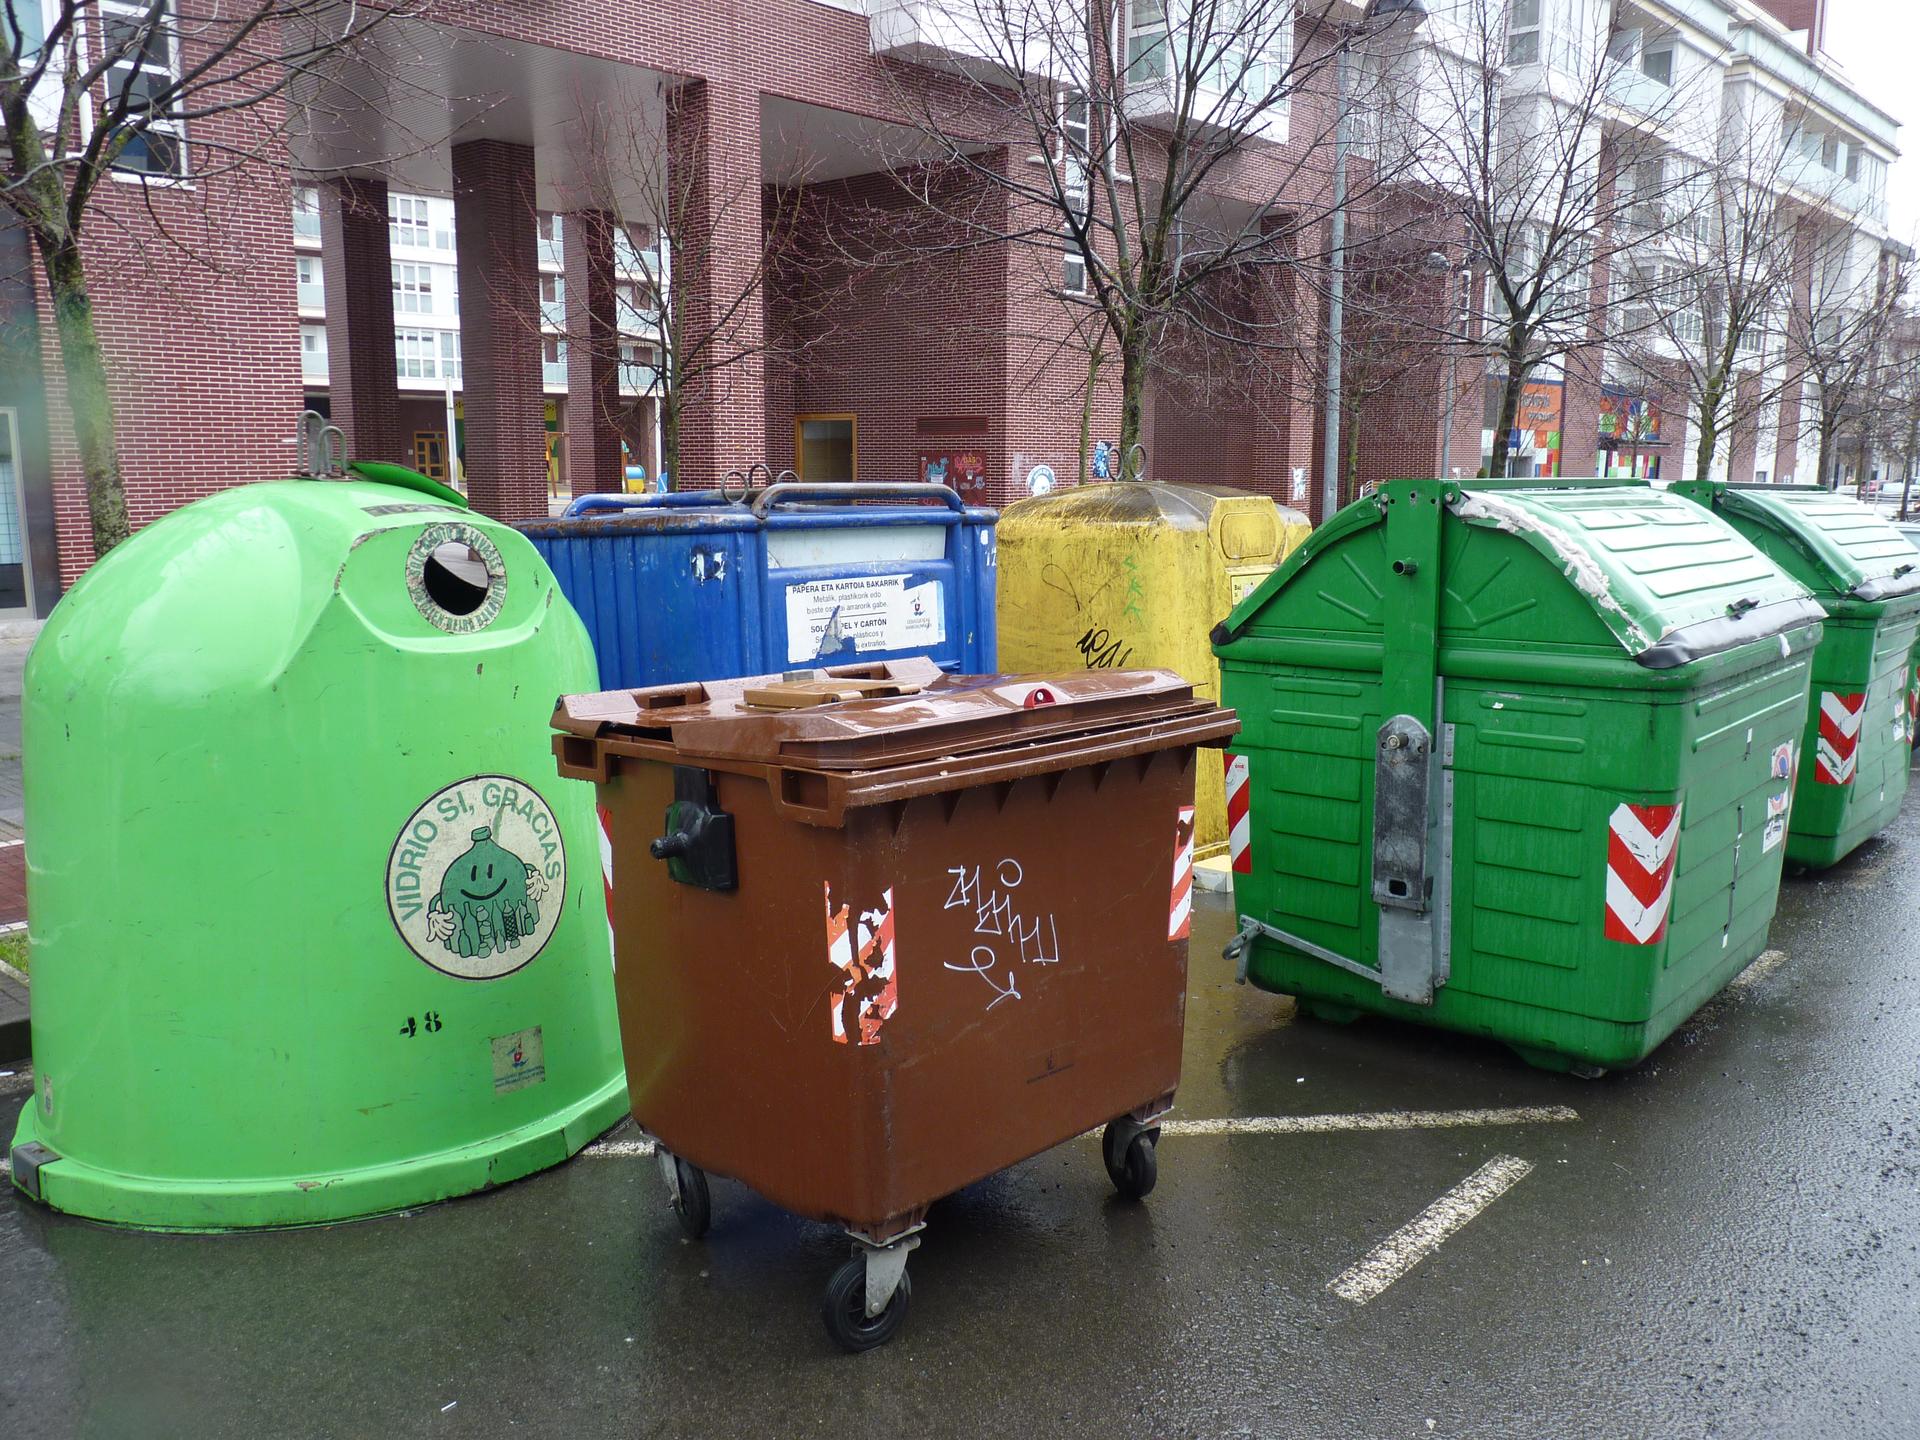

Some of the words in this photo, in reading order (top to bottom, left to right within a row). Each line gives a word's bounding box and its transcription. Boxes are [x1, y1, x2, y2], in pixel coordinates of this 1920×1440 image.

[792, 585, 819, 594] PAPERA
[821, 583, 834, 592] ETA
[835, 581, 865, 591] KARTOIA
[866, 579, 900, 588] BAKARRIK
[838, 591, 869, 602] plastikorik
[870, 591, 882, 599] edo
[853, 621, 859, 629] Y
[860, 618, 887, 628] CARTÓN
[879, 630, 884, 638] y
[395, 819, 438, 922] VIDRIO
[437, 791, 475, 822] SI,
[482, 783, 561, 880] GRACIAS
